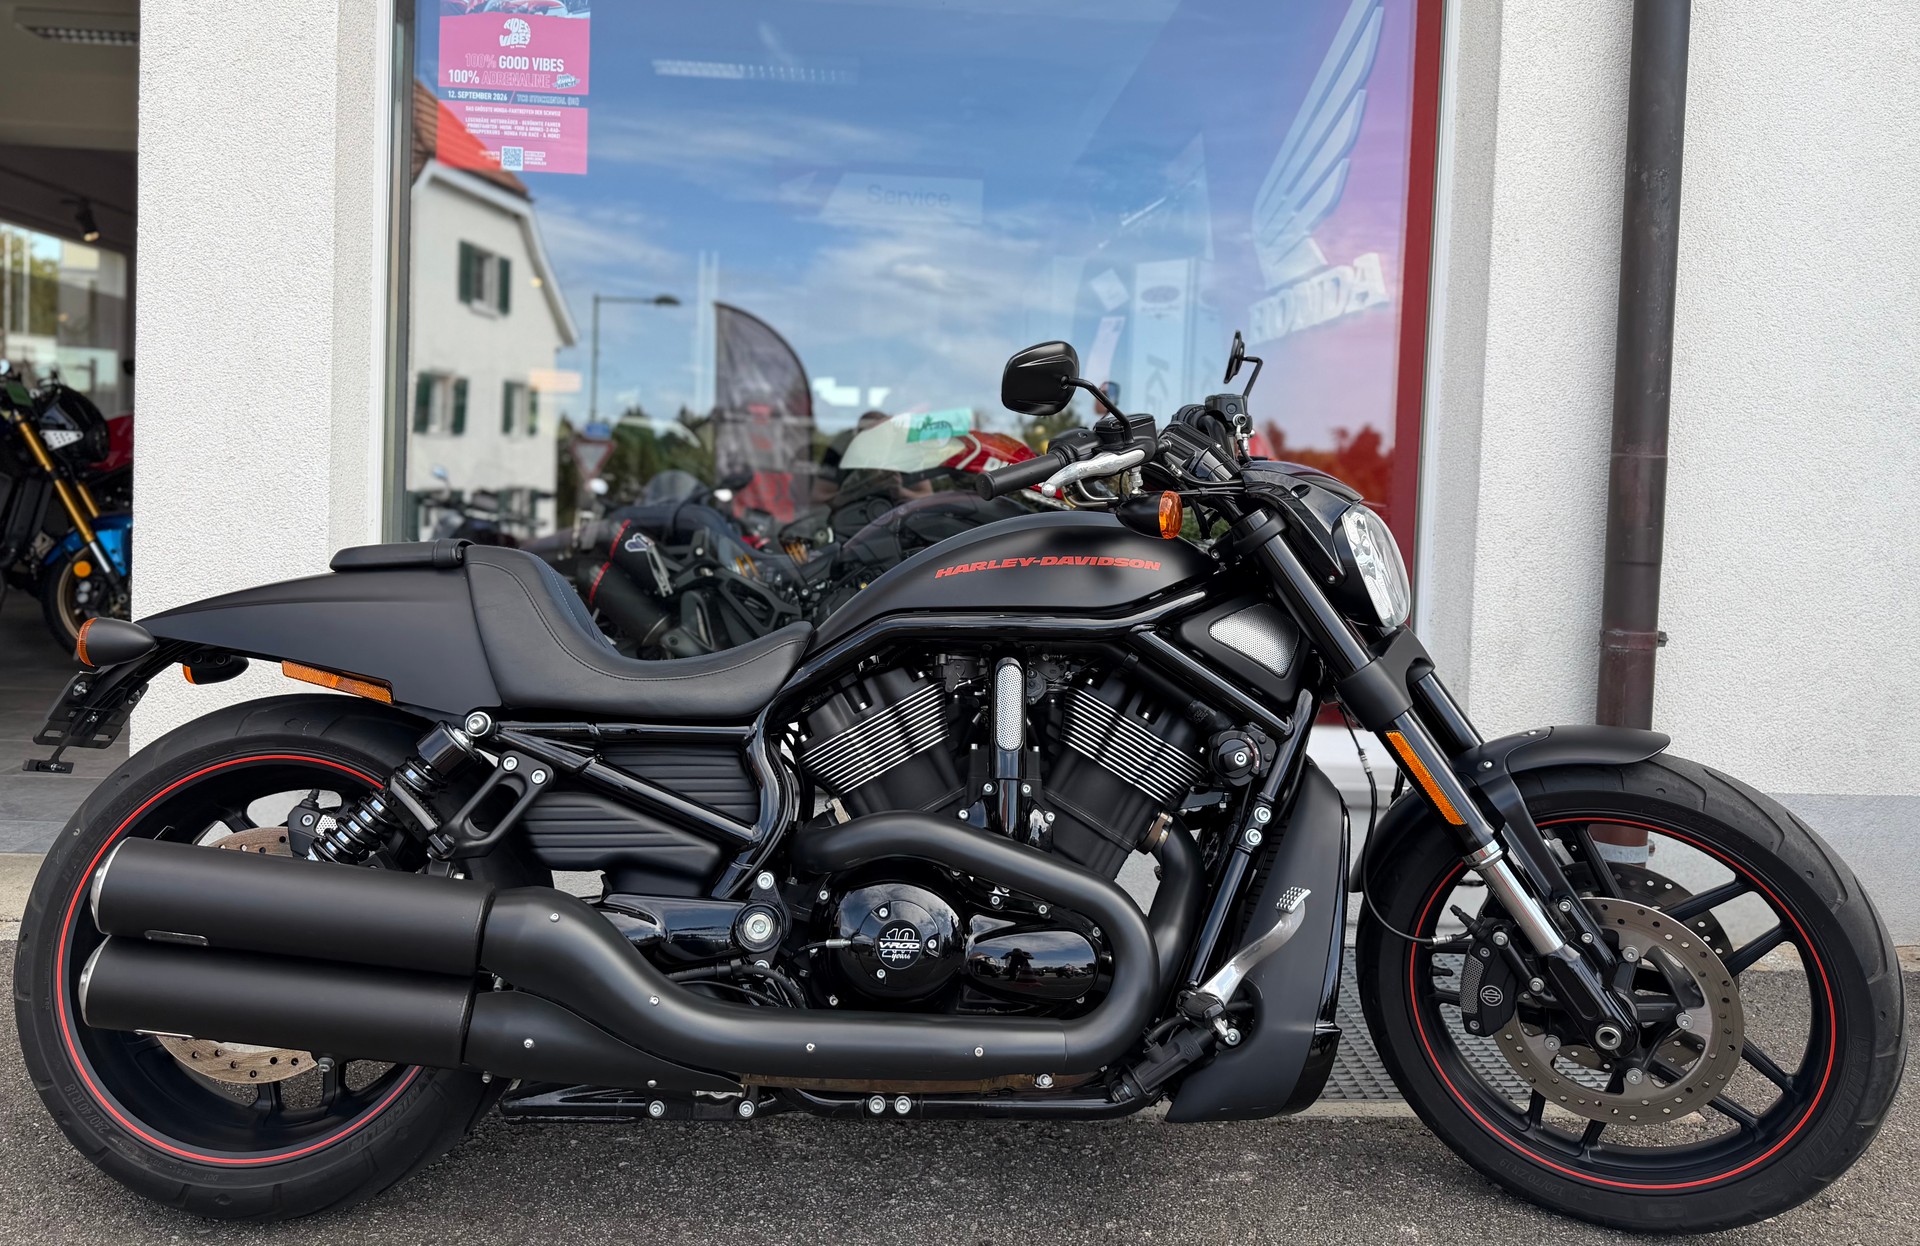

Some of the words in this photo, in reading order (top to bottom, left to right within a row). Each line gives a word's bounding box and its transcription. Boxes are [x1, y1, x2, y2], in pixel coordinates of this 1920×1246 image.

[499, 32, 531, 47] VIBES
[465, 53, 496, 68] 100%
[499, 55, 529, 70] GOOD
[532, 57, 564, 72] VIBES
[448, 69, 480, 84] 100%
[481, 71, 551, 88] ADRENALINE
[448, 90, 456, 98] 12.
[457, 91, 492, 100] SEPTEMBER
[493, 93, 508, 101] 2026
[866, 183, 952, 208] Service
[1247, 252, 1391, 347] HONDA
[934, 556, 1161, 579] HARLEY-DAVIDSON
[77, 1102, 110, 1134] 240/40
